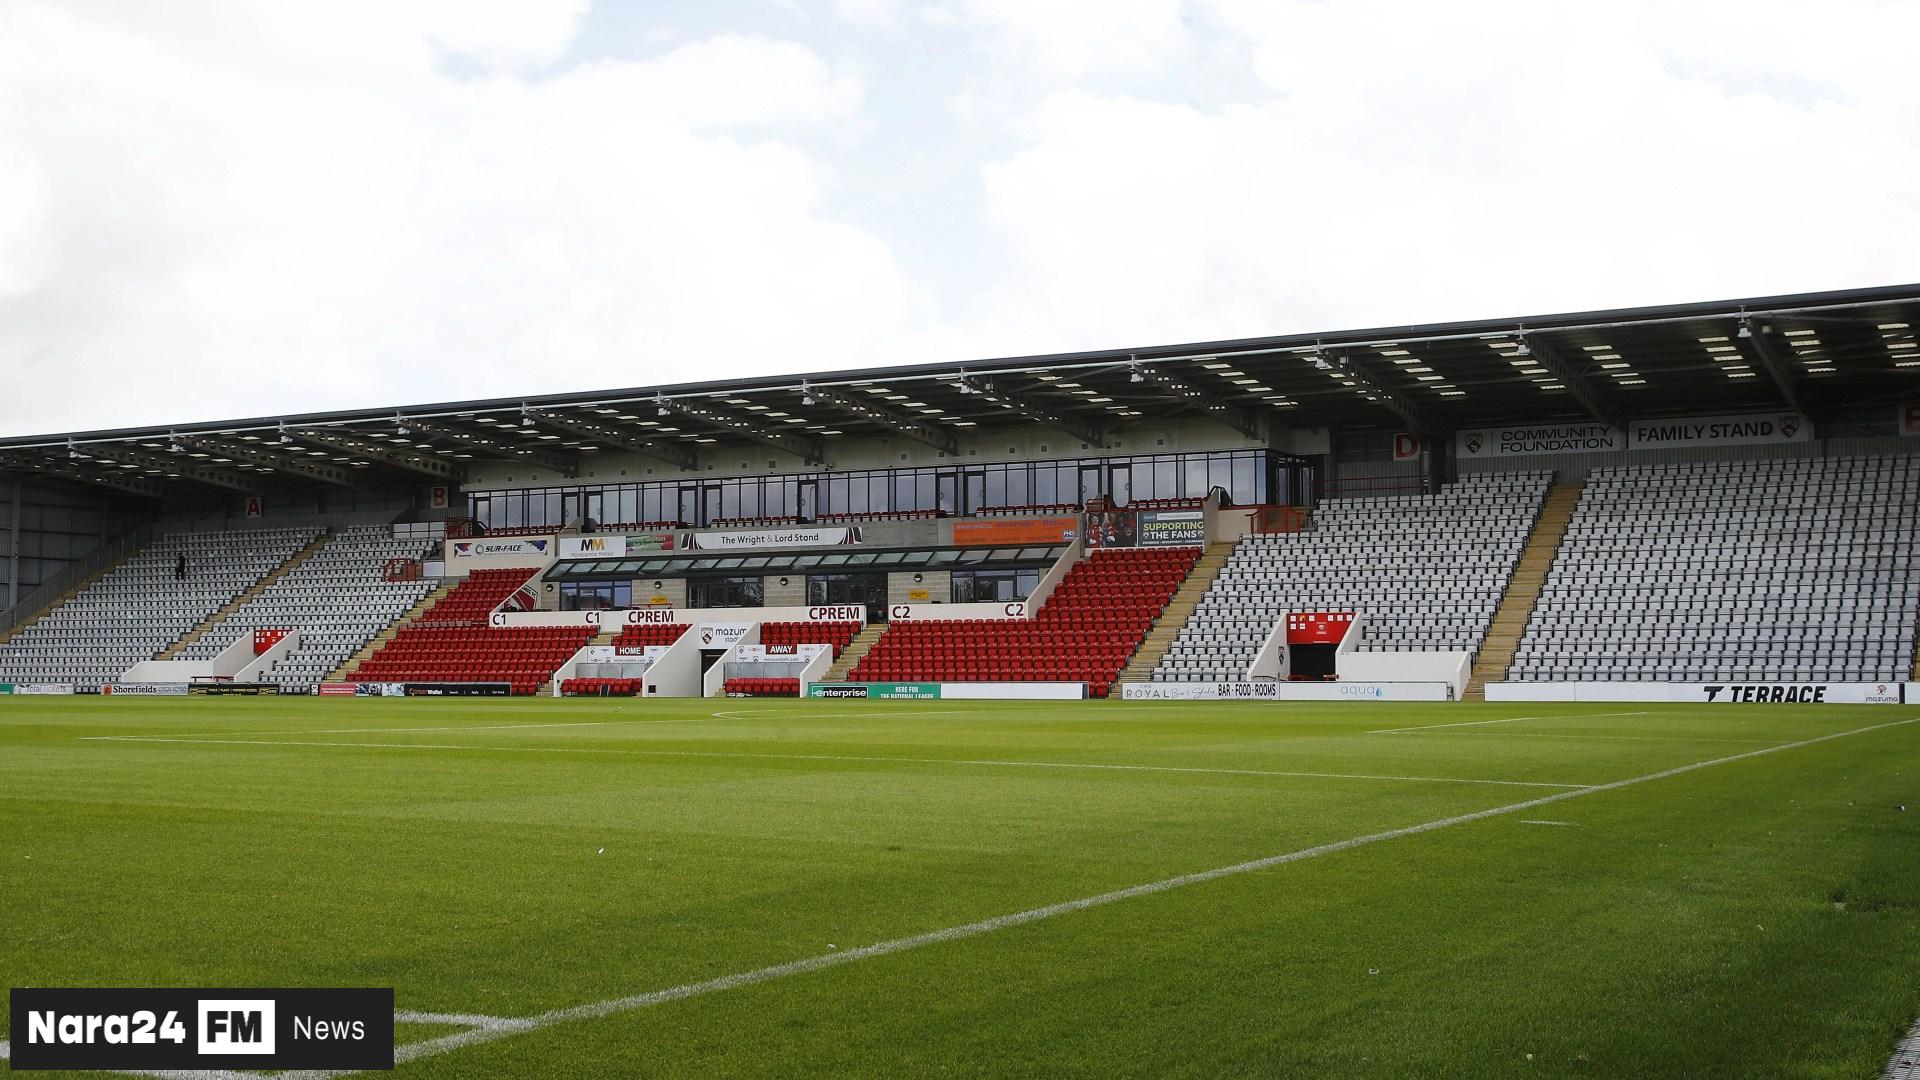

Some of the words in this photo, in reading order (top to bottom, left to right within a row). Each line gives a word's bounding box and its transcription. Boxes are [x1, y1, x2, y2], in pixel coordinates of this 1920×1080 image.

[1501, 426, 1611, 442] COMMUNITY
[1637, 425, 1705, 442] FAMILY
[1709, 421, 1773, 438] STAND
[1395, 434, 1419, 458] D
[1500, 437, 1613, 453] FOUNDATION
[432, 487, 446, 506] B
[247, 498, 261, 516] A
[1143, 521, 1204, 531] SUPPORTING
[721, 536, 736, 545] The
[737, 535, 765, 545] Wright
[767, 535, 773, 543] &
[775, 534, 793, 543] Lord
[794, 533, 819, 542] Stand
[1150, 531, 1169, 539] THE
[1171, 530, 1197, 539] FANS
[485, 544, 523, 553] SUR-FACE
[808, 606, 860, 620] CPREM
[892, 606, 911, 619] C2
[1004, 604, 1024, 616] C2
[492, 614, 506, 625] C1
[585, 612, 600, 623] C1
[628, 610, 674, 623] CPREM
[715, 628, 747, 636] mazum
[619, 647, 641, 655] HOME
[770, 645, 793, 653] AWAY
[113, 685, 157, 693] Shorefields
[815, 687, 867, 698] enterprise
[1126, 689, 1170, 698] ROYAL
[1217, 684, 1231, 696] BAR
[1235, 684, 1251, 696] FOOD
[1254, 683, 1276, 696] ROOMS
[1340, 685, 1375, 697] aqua
[1731, 686, 1827, 703] TERRACE
